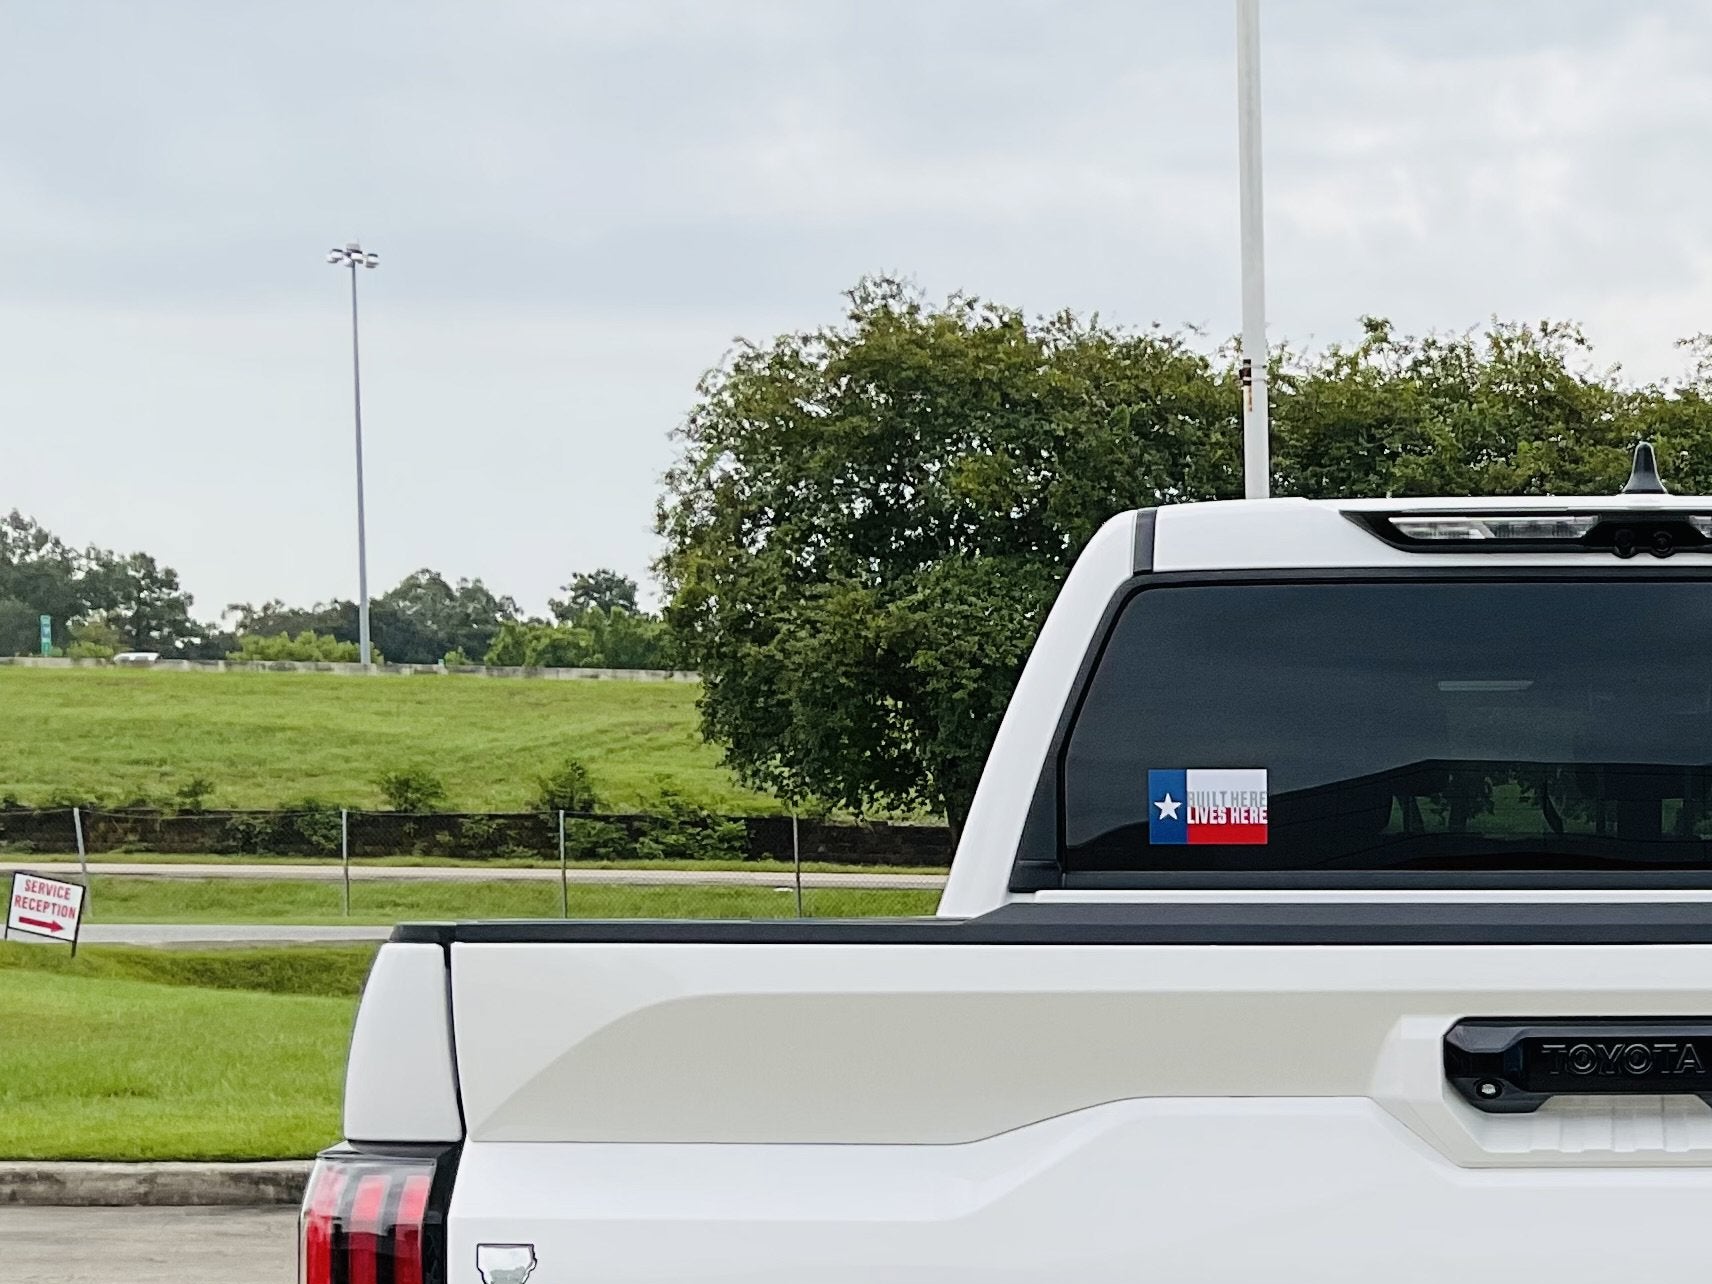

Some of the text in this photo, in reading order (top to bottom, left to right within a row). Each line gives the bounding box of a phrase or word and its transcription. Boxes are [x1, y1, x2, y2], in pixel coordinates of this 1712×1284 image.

[1187, 791, 1267, 807] BUILT HERE
[1187, 807, 1268, 824] LIVES HERE
[24, 879, 72, 900] SERVICE
[14, 894, 77, 919] RECEPTION
[1541, 1044, 1706, 1075] TOYOTA
